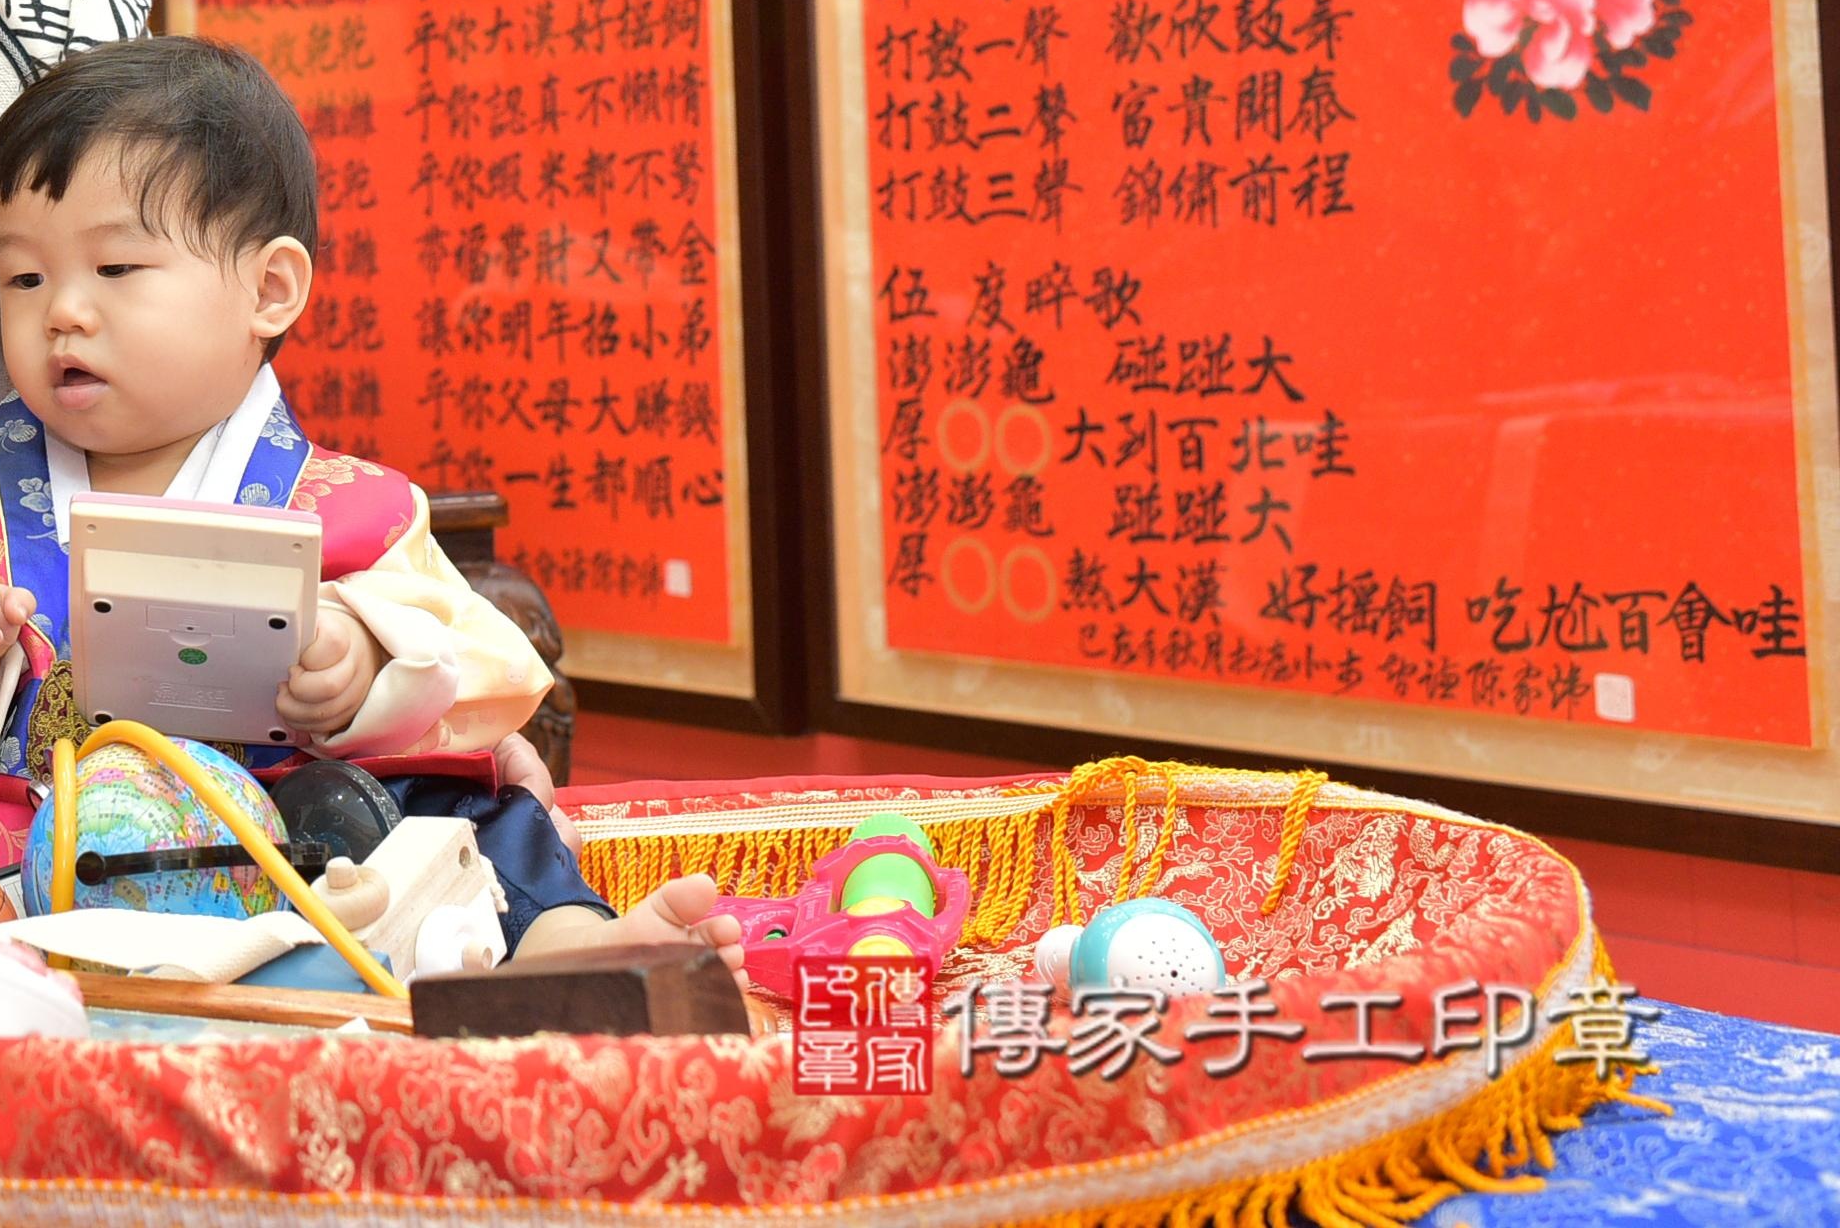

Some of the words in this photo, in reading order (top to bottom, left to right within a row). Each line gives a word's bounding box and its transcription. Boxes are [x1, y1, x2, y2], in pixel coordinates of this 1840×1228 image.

[875, 4, 1070, 84] 打鼓一聲
[875, 81, 1080, 153] 打鼓二聲
[1111, 64, 1357, 150] 富貴開泰
[875, 158, 1084, 234] 打鼓三聲
[1112, 151, 1355, 230] 錦繡前程
[878, 265, 938, 325] 伍
